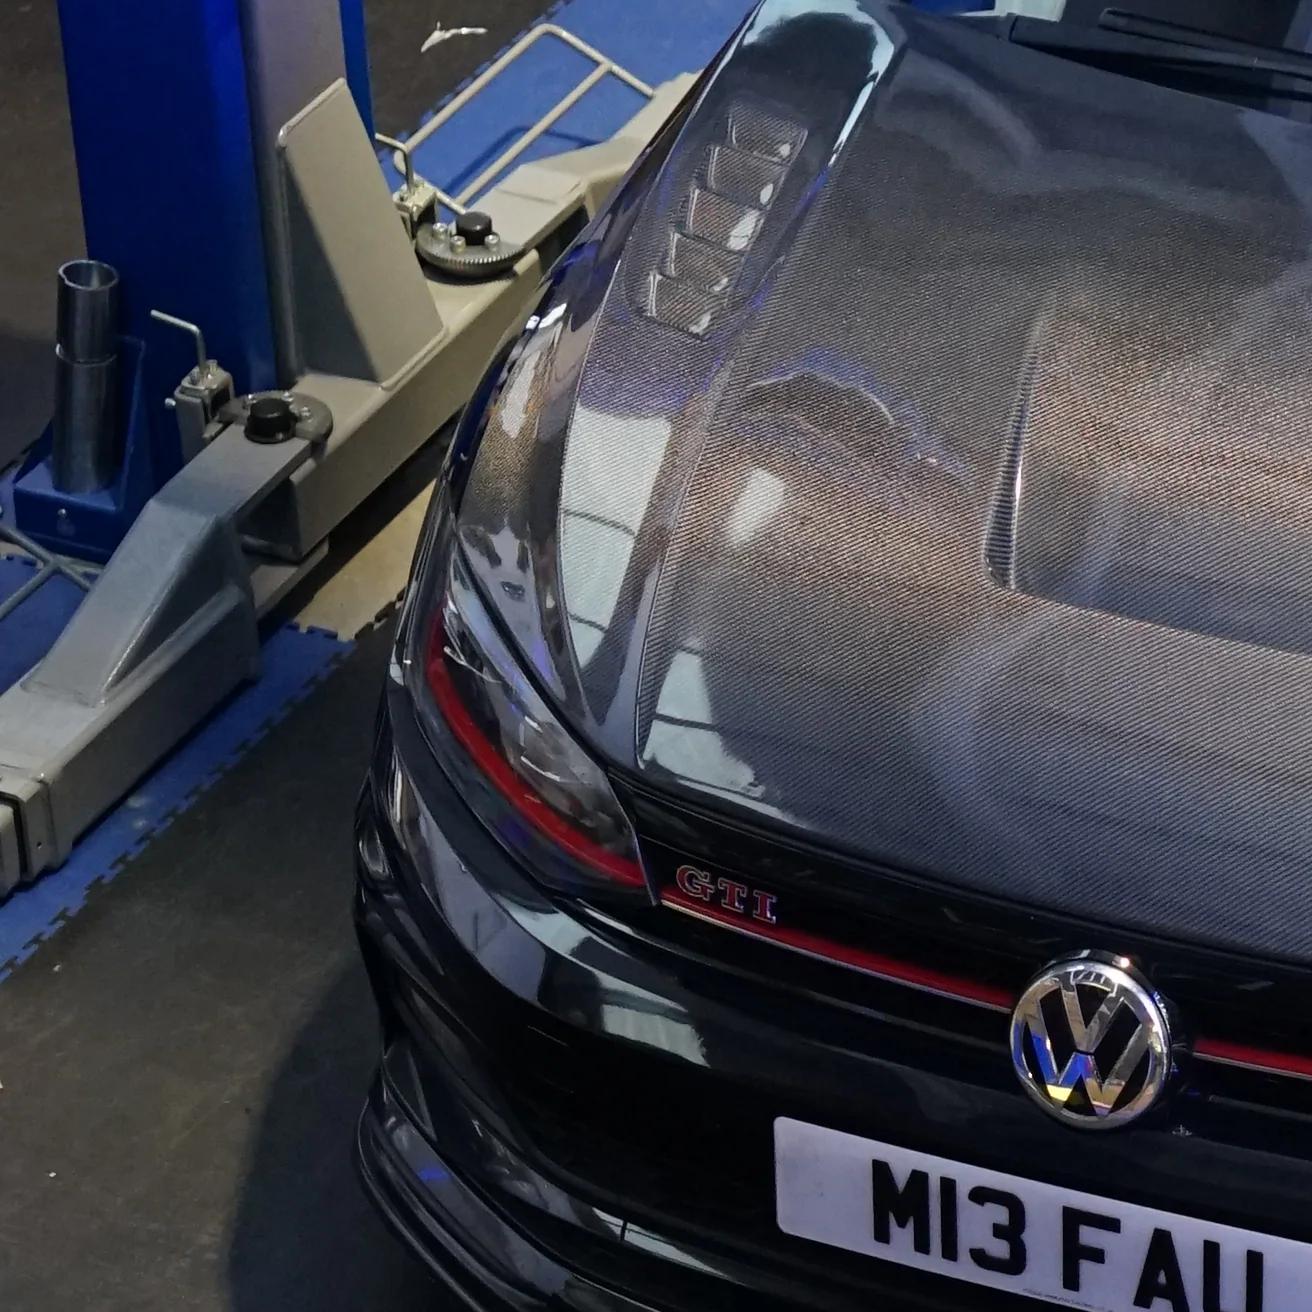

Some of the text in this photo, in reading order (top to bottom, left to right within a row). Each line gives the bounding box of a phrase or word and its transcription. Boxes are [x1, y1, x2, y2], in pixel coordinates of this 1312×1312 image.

[675, 864, 778, 925] GTI
[1016, 966, 1161, 1122] VW
[871, 1158, 1028, 1277] M13
